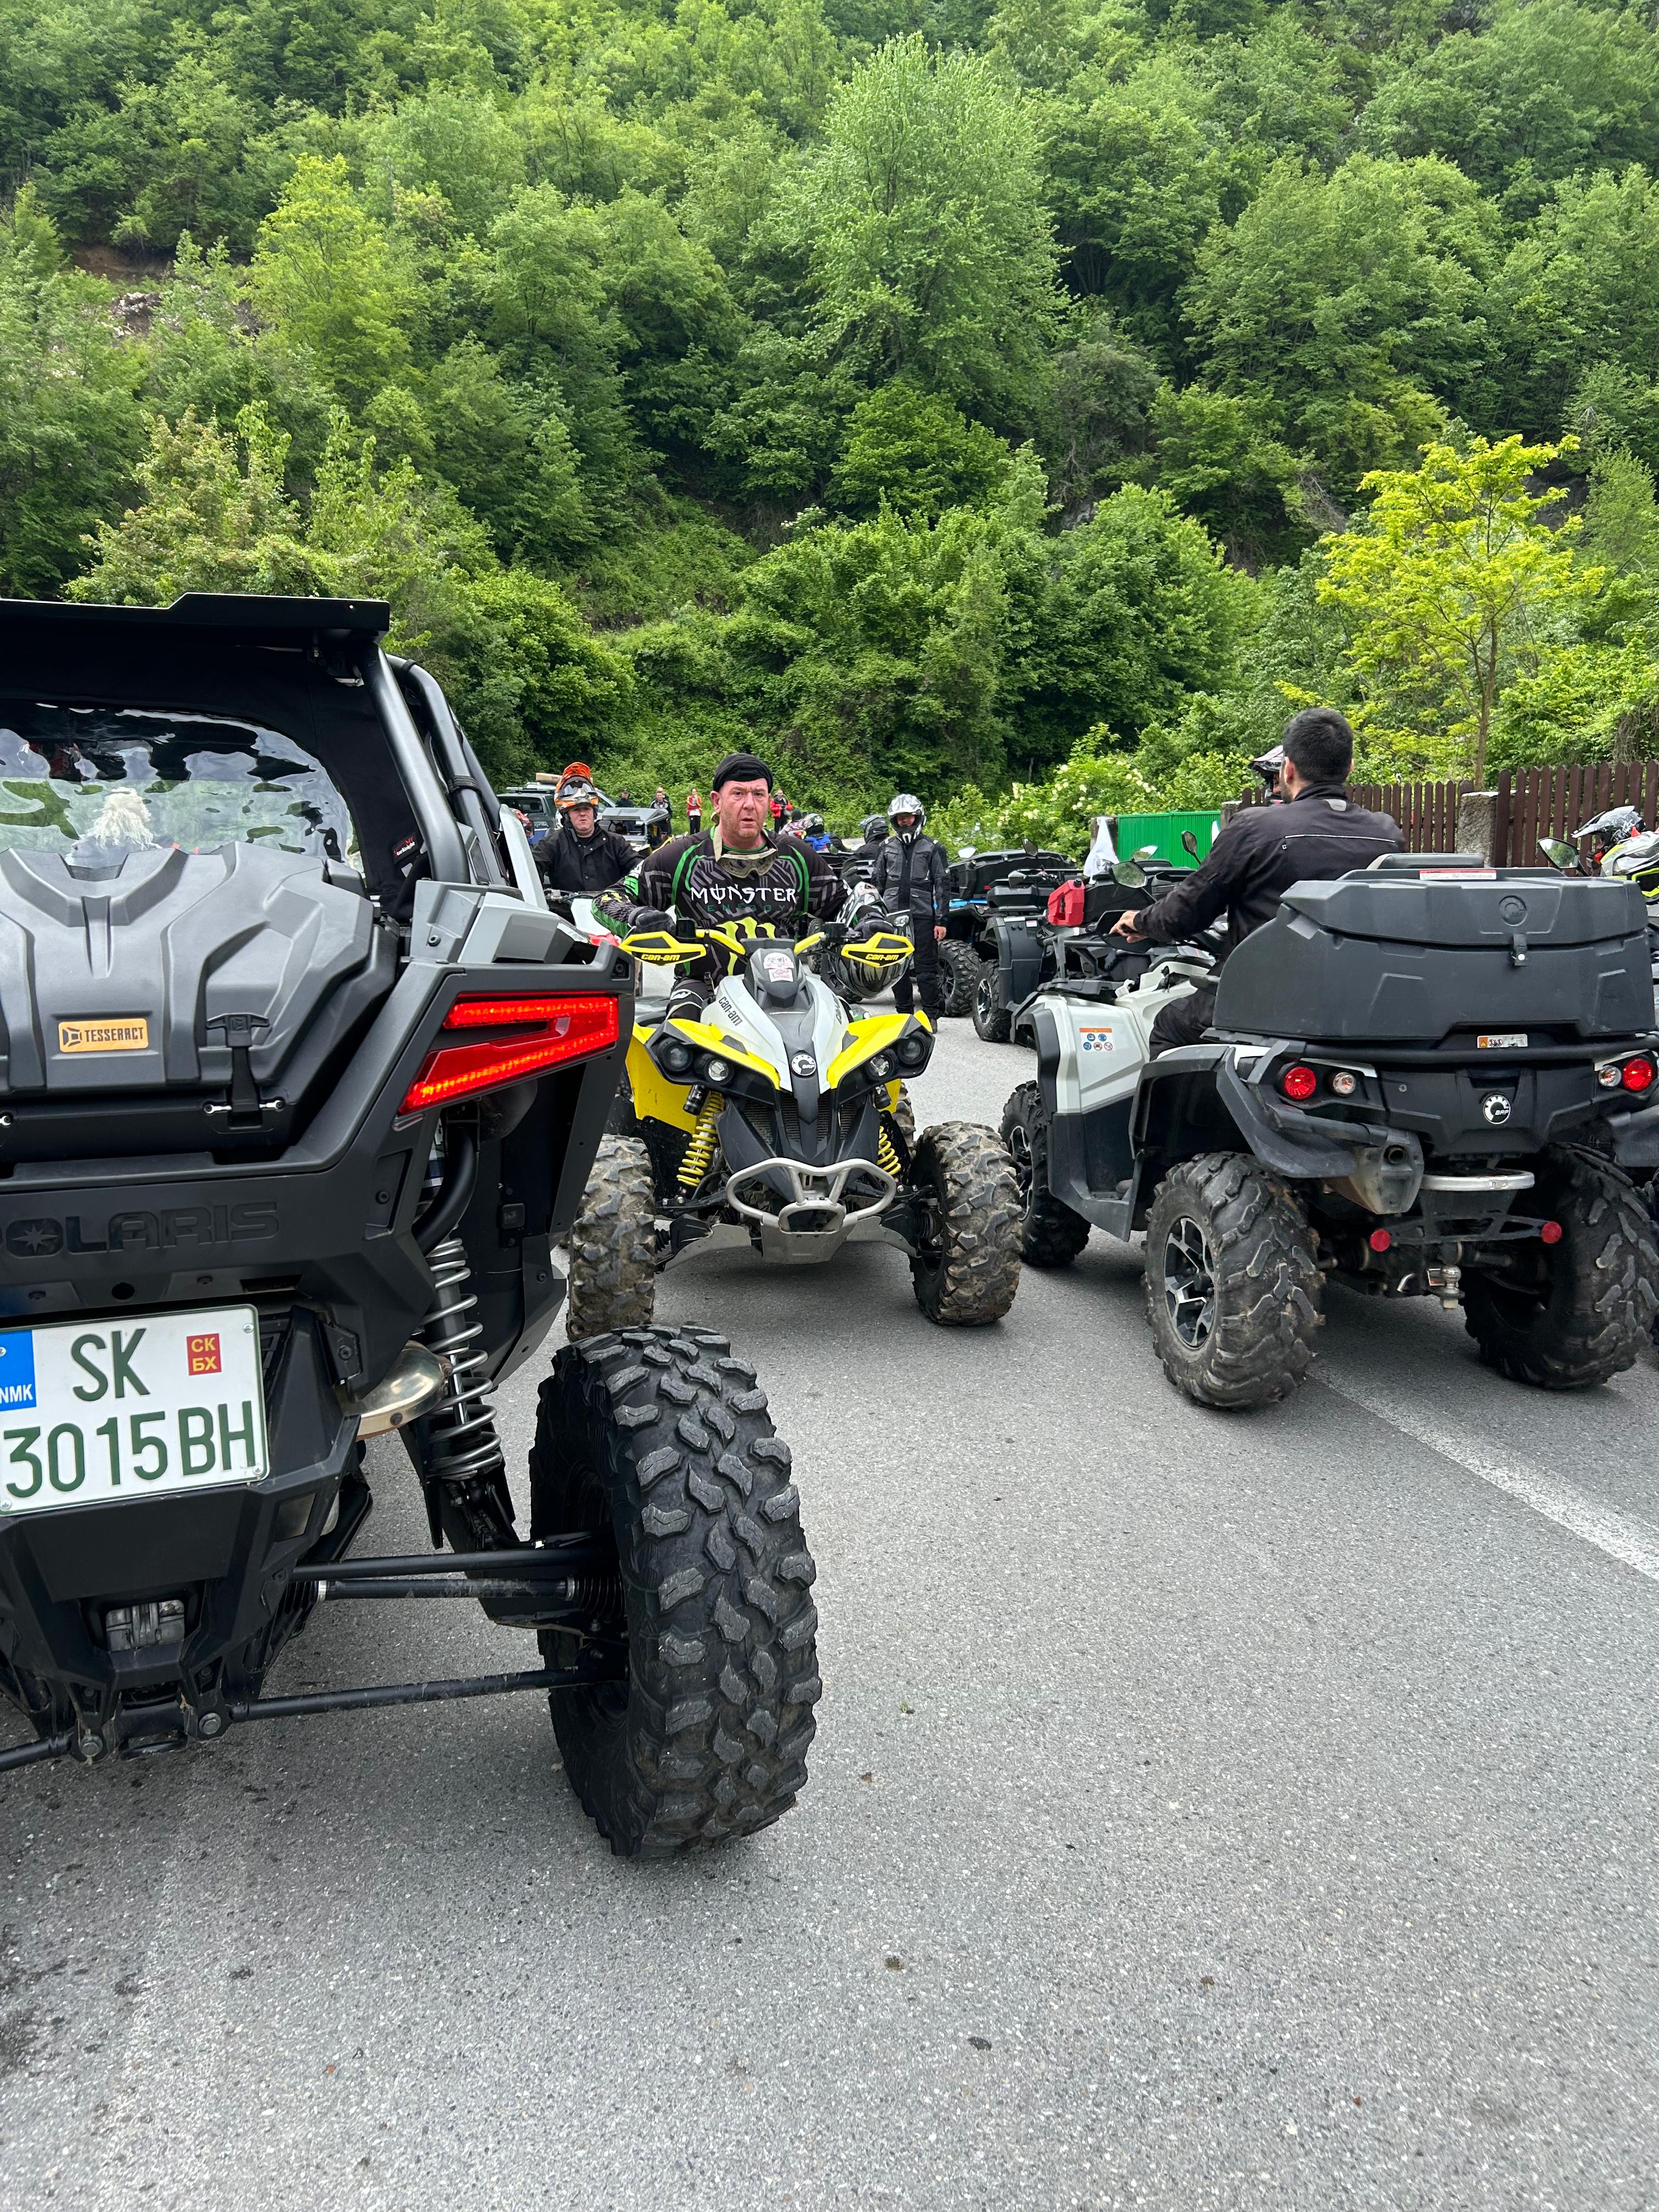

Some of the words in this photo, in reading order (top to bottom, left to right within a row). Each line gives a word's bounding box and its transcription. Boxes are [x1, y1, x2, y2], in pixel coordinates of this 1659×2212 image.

[691, 883, 797, 904] MONSTER
[718, 996, 743, 1026] can-am
[84, 1027, 144, 1042] TESSERACT
[0, 1201, 279, 1259] OLARIS
[191, 1337, 216, 1353] СК
[71, 1328, 150, 1402] SK
[193, 1356, 218, 1372] БХ
[0, 1384, 33, 1404] NMK
[3, 1401, 256, 1498] 3015BH
